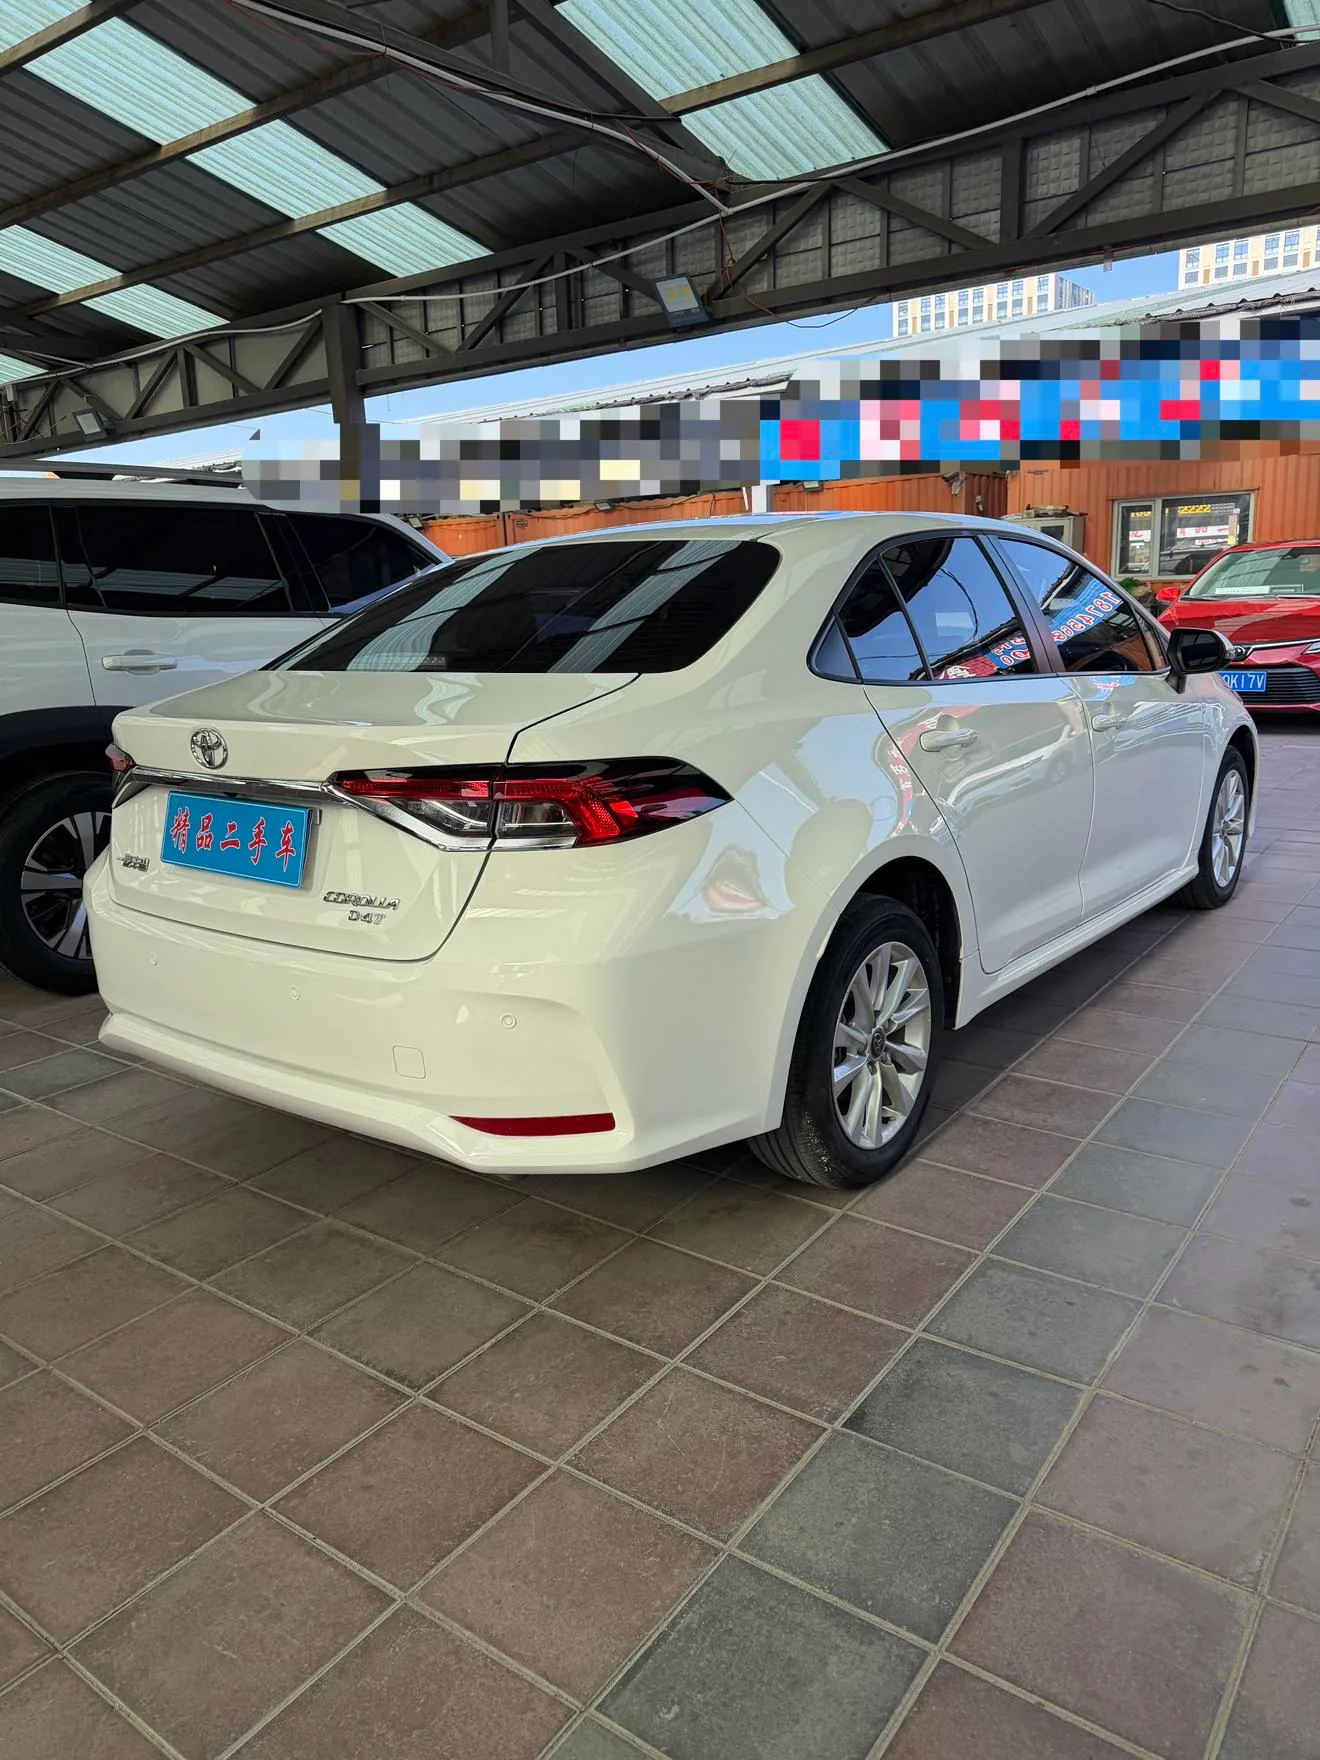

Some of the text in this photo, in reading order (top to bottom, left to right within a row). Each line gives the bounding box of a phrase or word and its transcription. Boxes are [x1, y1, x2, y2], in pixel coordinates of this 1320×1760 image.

[170, 806, 297, 872] 精品二手车
[323, 891, 401, 910] COROLLA
